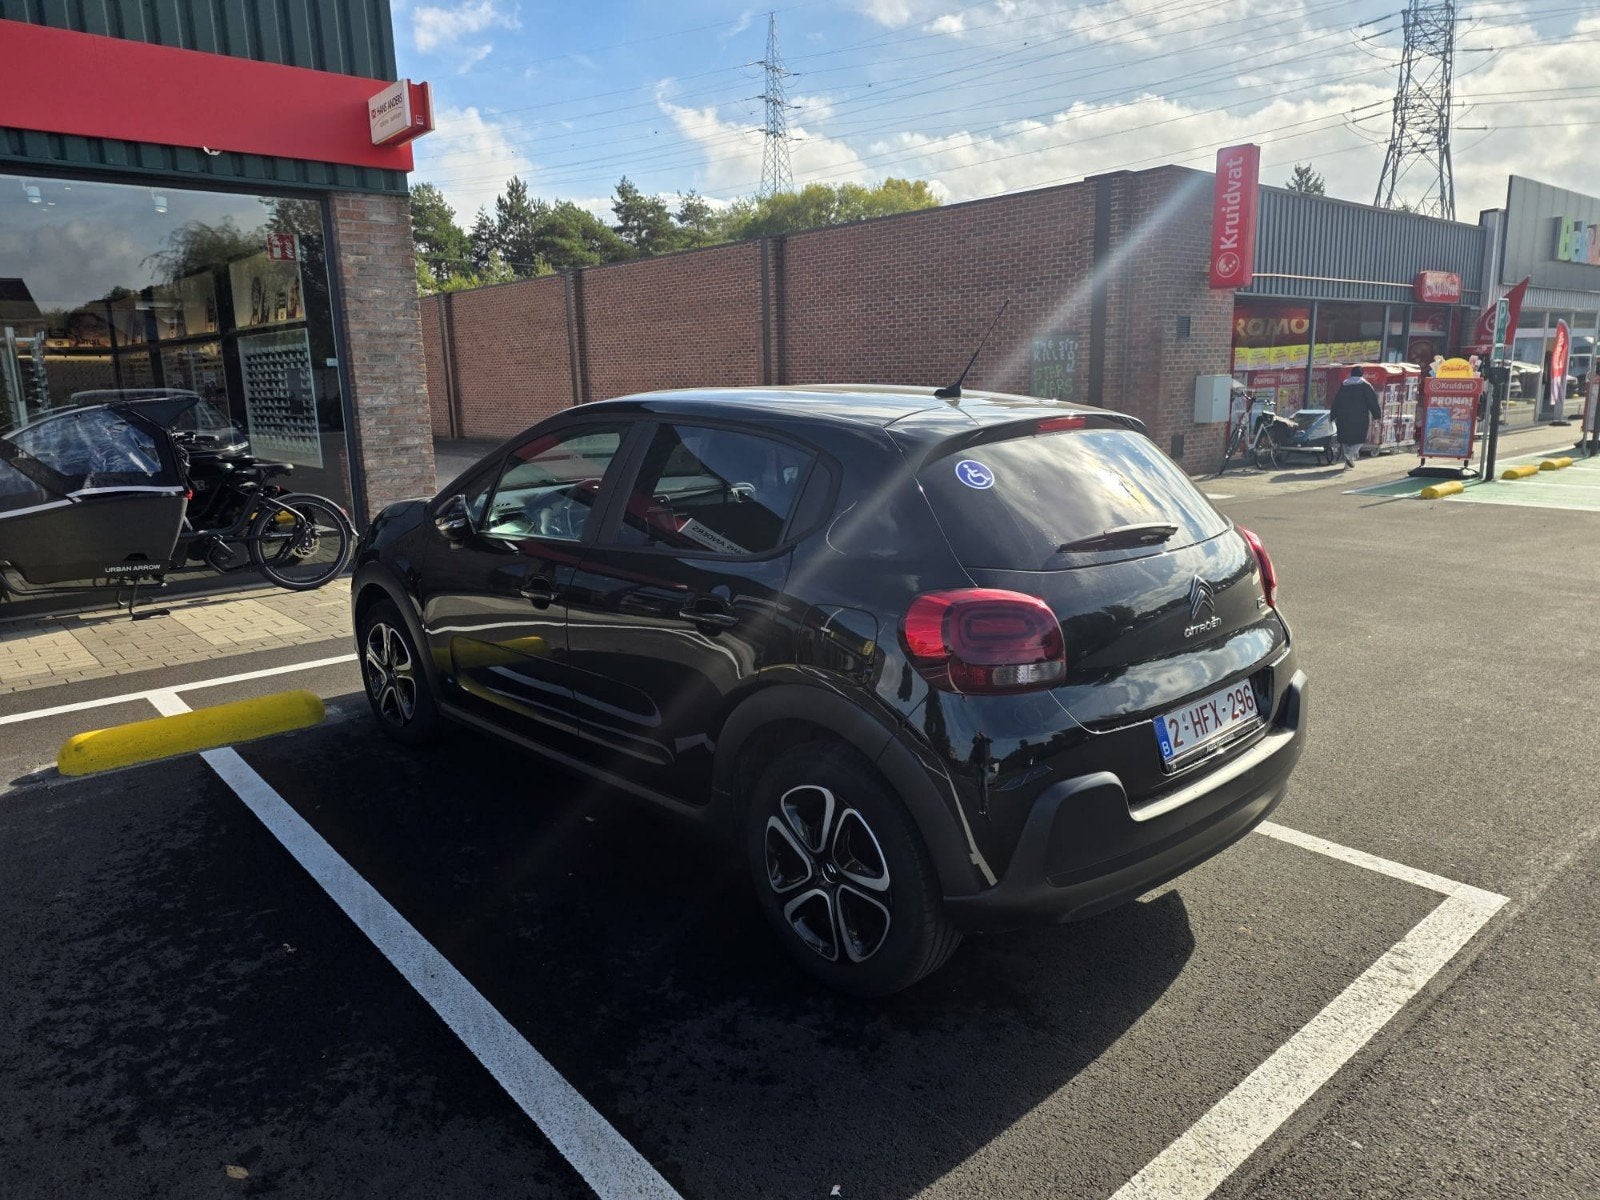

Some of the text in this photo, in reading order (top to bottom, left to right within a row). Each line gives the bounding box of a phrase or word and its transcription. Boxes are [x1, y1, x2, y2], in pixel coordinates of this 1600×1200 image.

[387, 93, 402, 109] ANDERS
[1220, 156, 1243, 249] Kruidvat
[1441, 382, 1473, 390] Kruidvat
[1430, 397, 1473, 407] PROMO!
[105, 565, 132, 573] URBAN
[1168, 684, 1254, 749] 2-HFX-296
[1162, 741, 1170, 755] B
